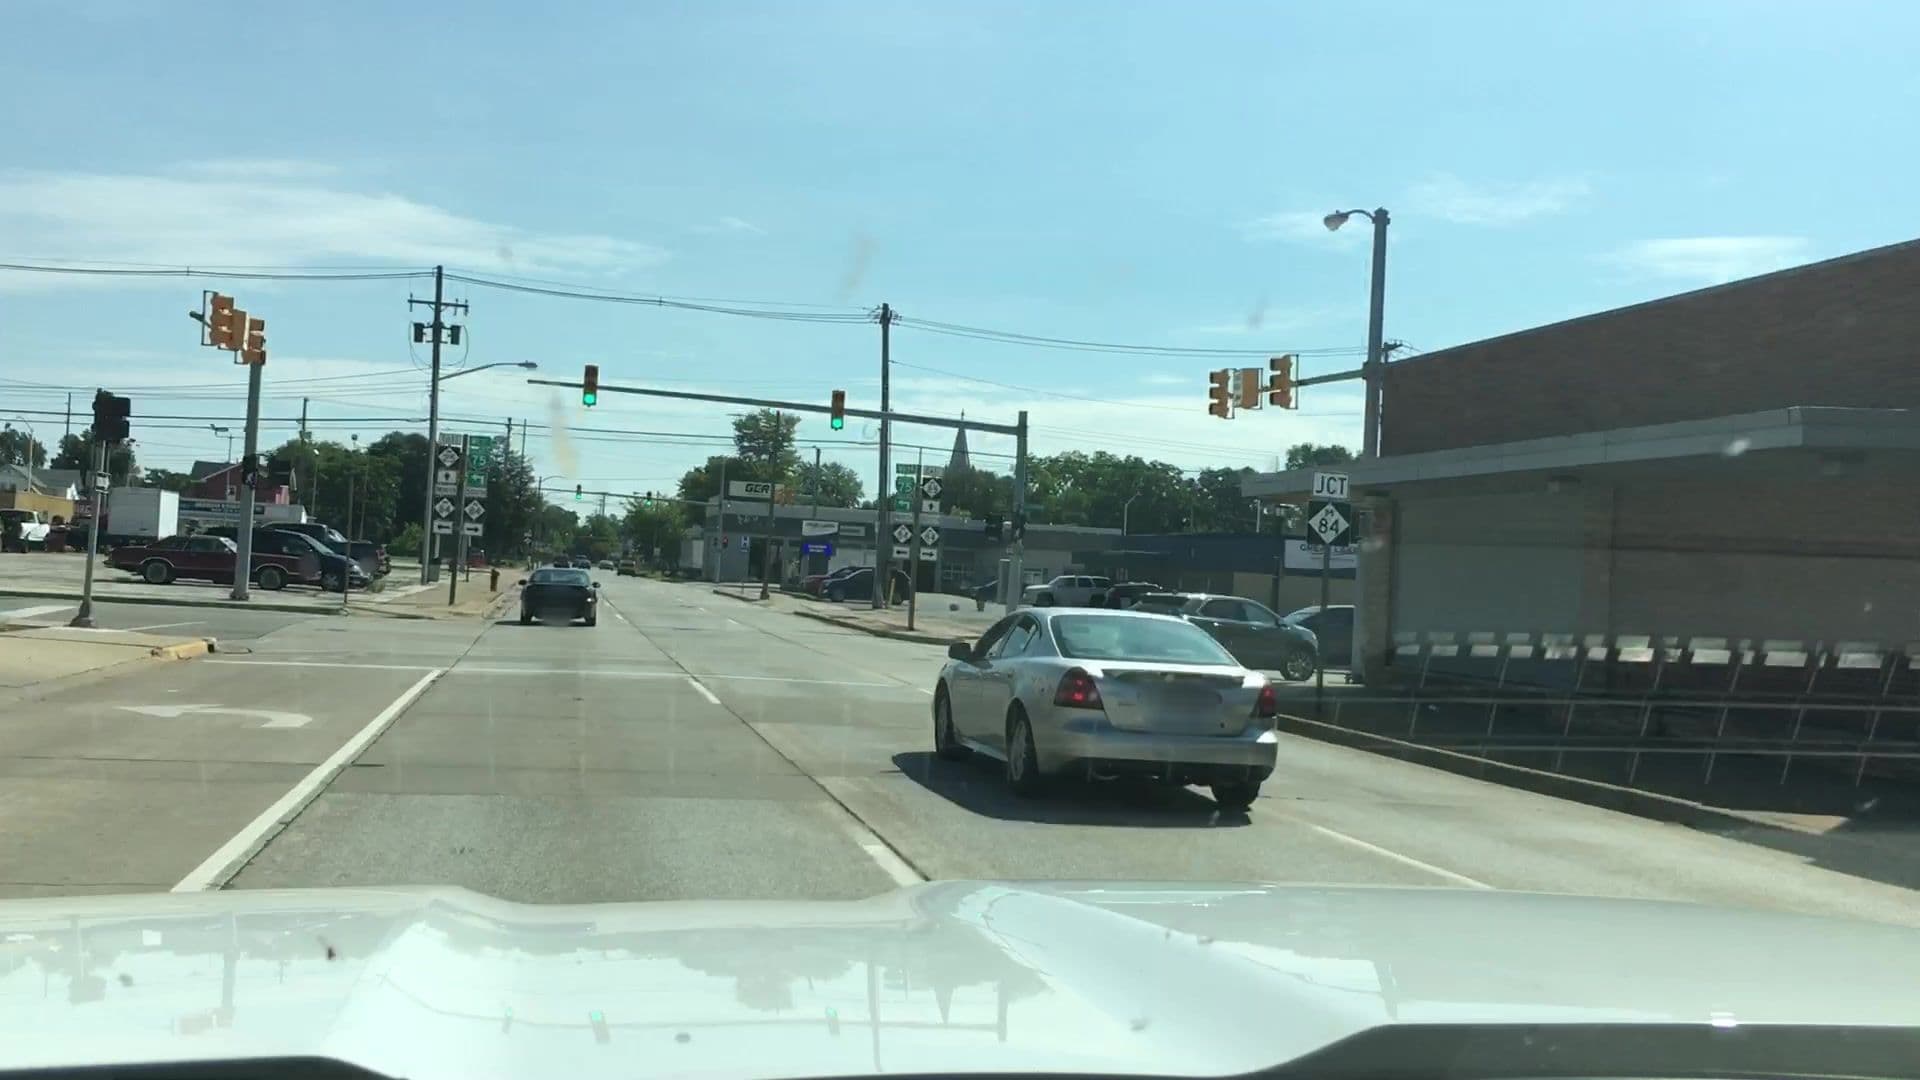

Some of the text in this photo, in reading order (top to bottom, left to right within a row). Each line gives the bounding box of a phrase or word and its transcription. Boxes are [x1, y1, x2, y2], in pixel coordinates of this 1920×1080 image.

[472, 454, 487, 466] 75
[1315, 475, 1347, 495] JCT
[1318, 518, 1340, 534] 84
